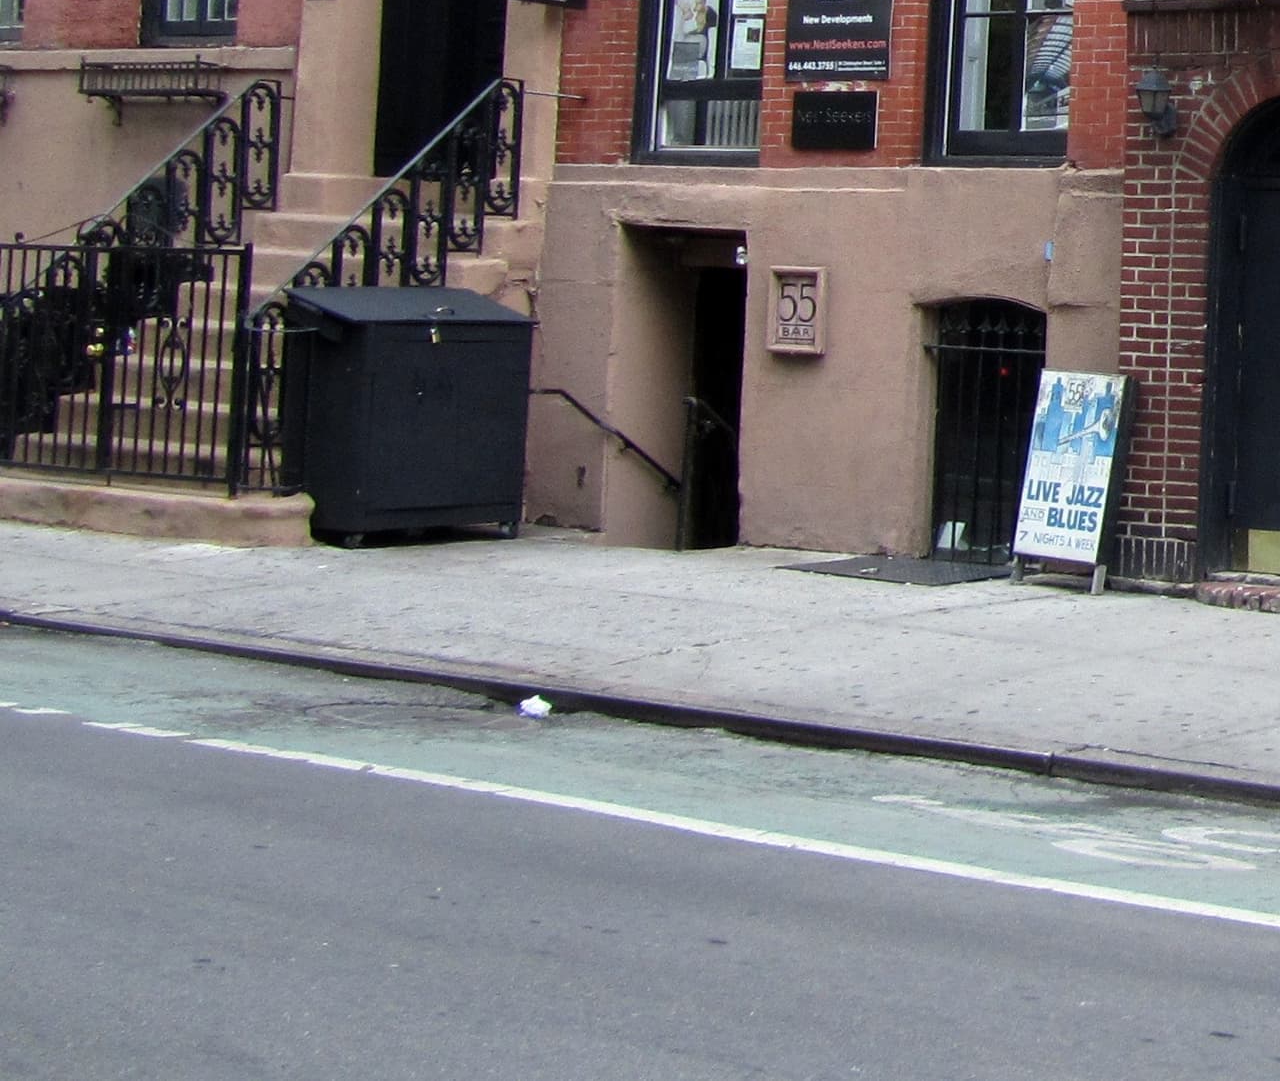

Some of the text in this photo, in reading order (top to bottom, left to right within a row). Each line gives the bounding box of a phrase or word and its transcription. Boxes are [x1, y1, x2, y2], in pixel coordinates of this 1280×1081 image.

[802, 14, 873, 25] New Developments
[780, 283, 817, 322] 55
[782, 326, 811, 337] BAR
[1027, 479, 1105, 508] LIVE JAZZ
[1023, 507, 1098, 532] AND BLUES
[1019, 531, 1028, 541] 7
[1033, 533, 1065, 547] NIGHTS
[1075, 538, 1095, 551] WEEK
